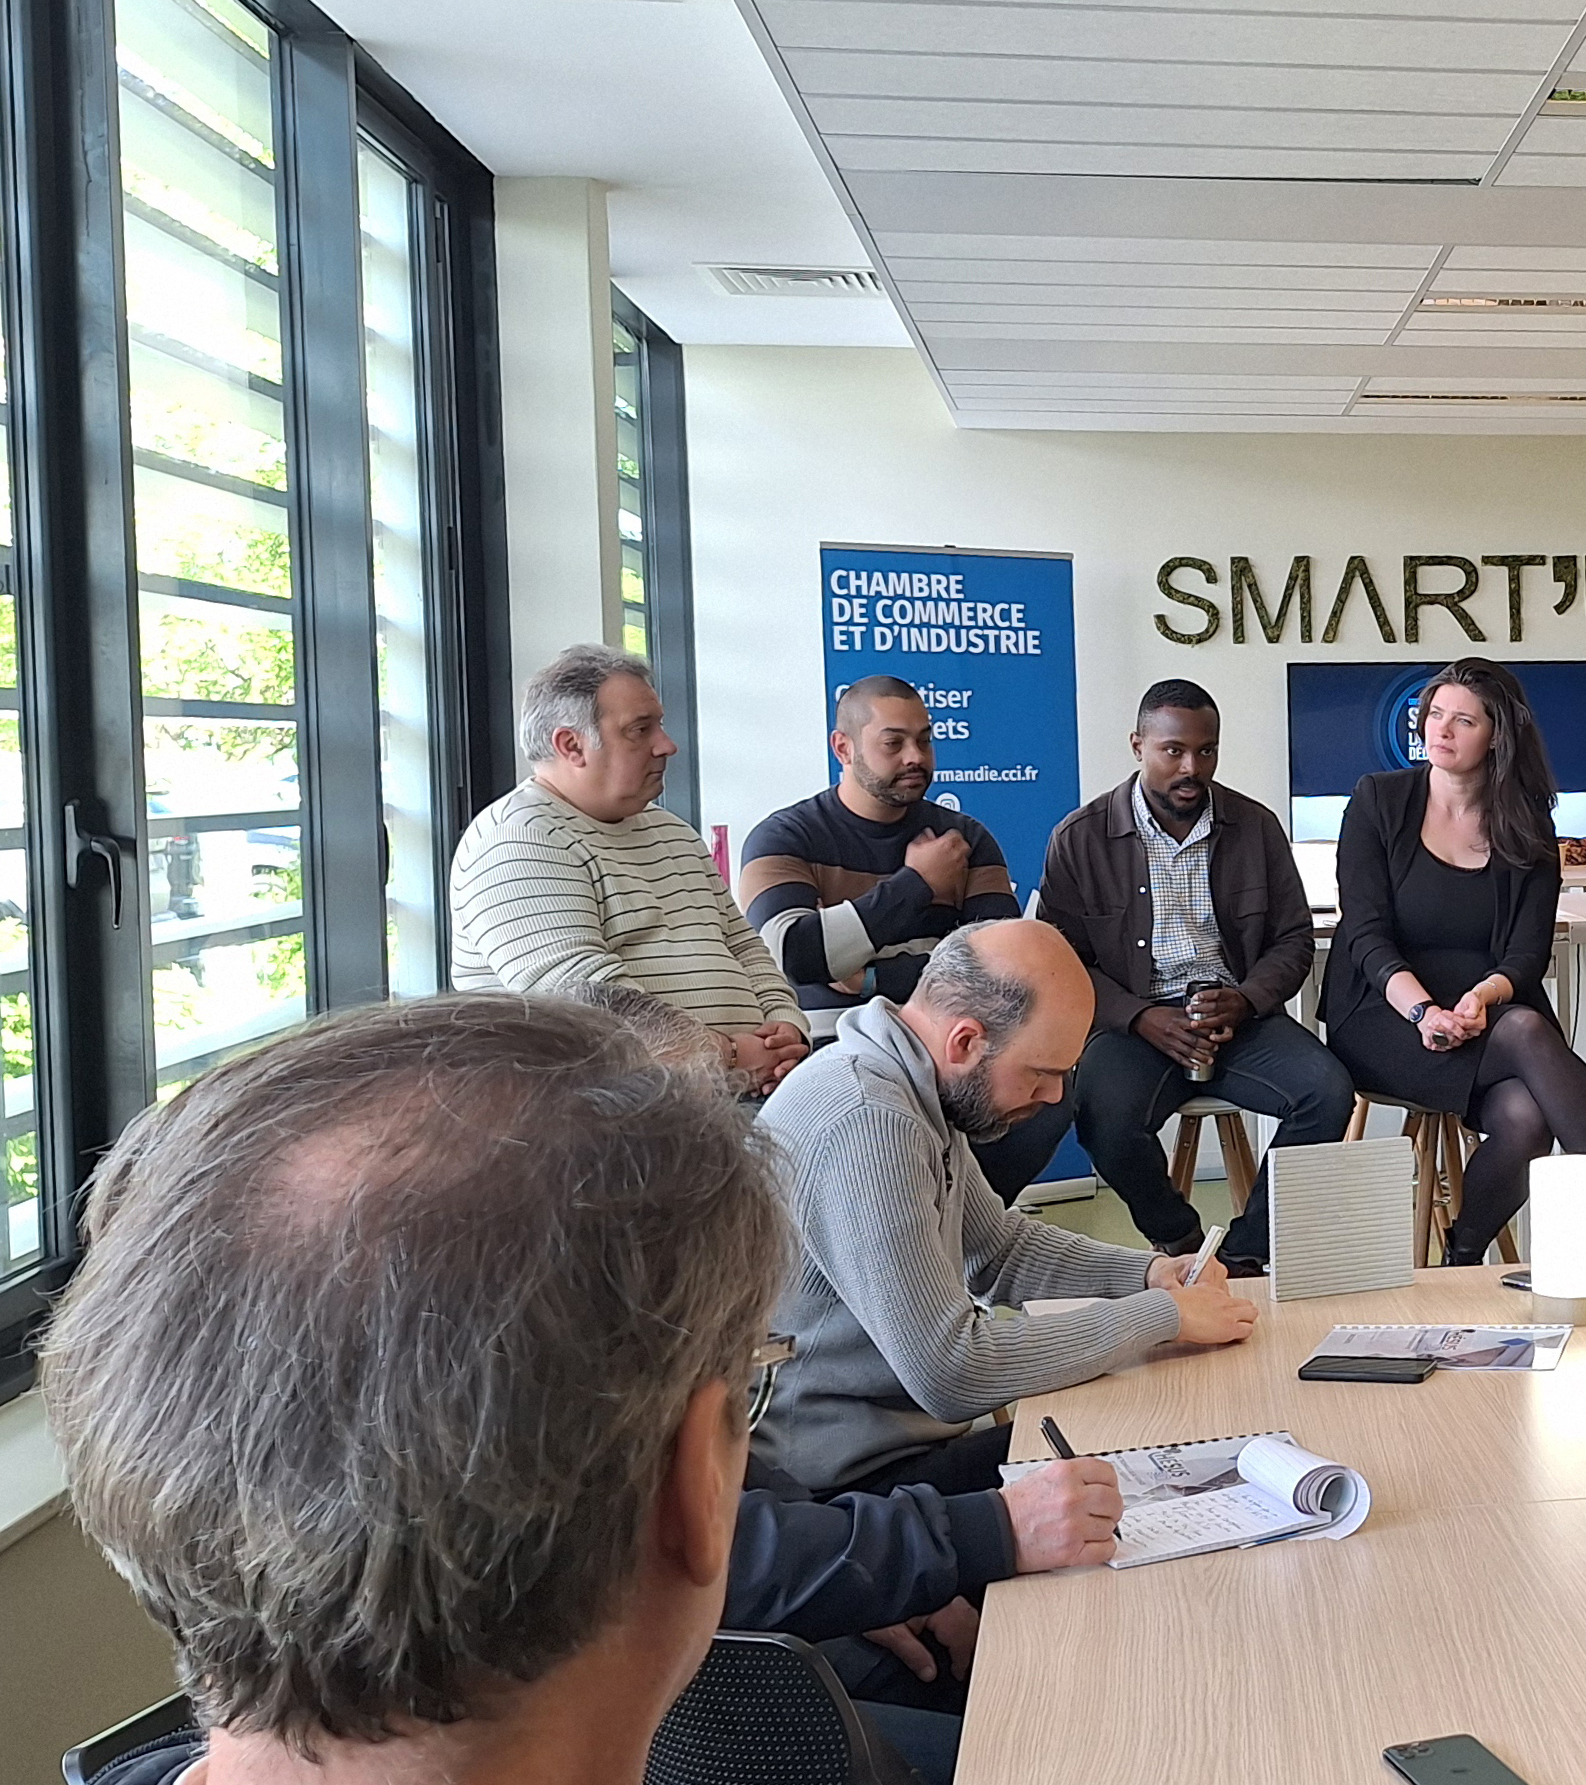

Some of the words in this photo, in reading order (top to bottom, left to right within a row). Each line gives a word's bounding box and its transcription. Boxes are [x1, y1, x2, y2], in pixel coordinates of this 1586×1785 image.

[830, 569, 965, 599] CHAMBRE
[831, 597, 869, 624] DE
[875, 599, 1026, 628] COMMERCE
[833, 625, 867, 650] ET
[873, 626, 1042, 655] D'INDUSTRIE
[933, 764, 1039, 783] rmandie.cci.fr
